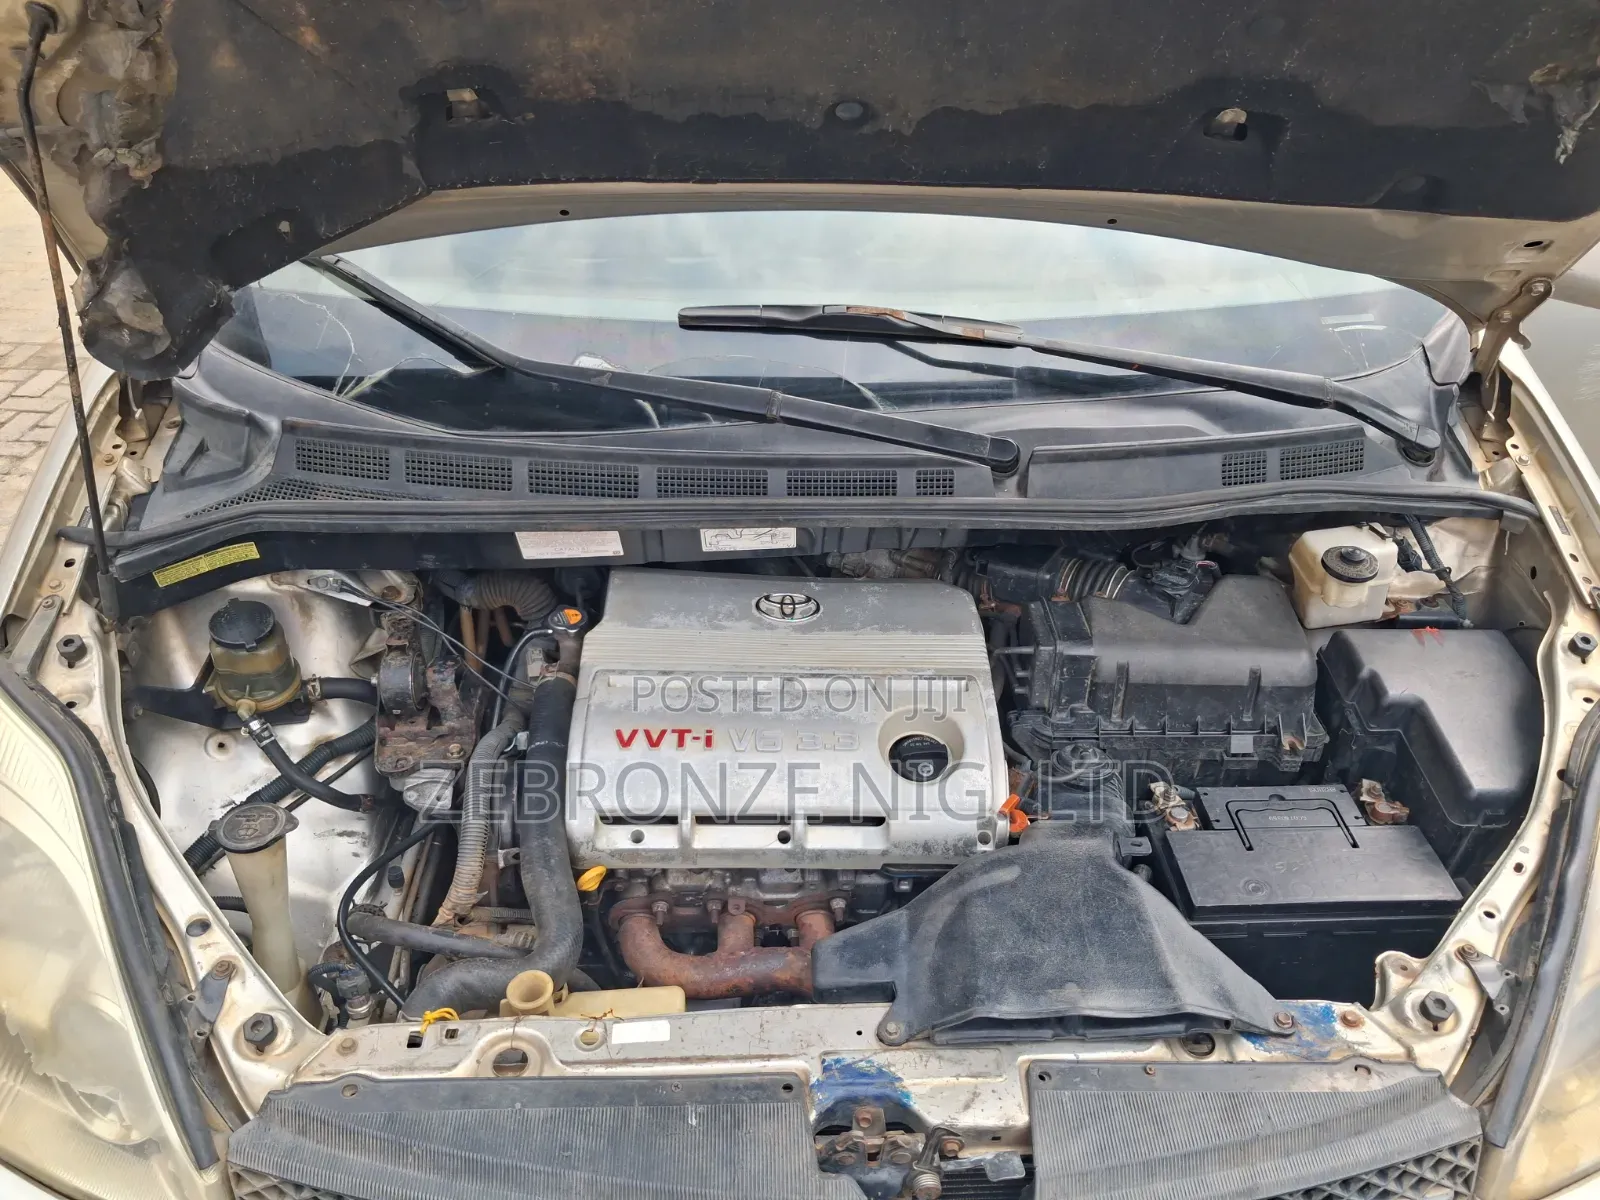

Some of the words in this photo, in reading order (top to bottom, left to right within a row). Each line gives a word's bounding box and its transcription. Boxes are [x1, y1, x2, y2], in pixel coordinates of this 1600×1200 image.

[615, 728, 714, 749] VVT-i
[728, 727, 784, 752] V6
[796, 728, 860, 751] 3.3
